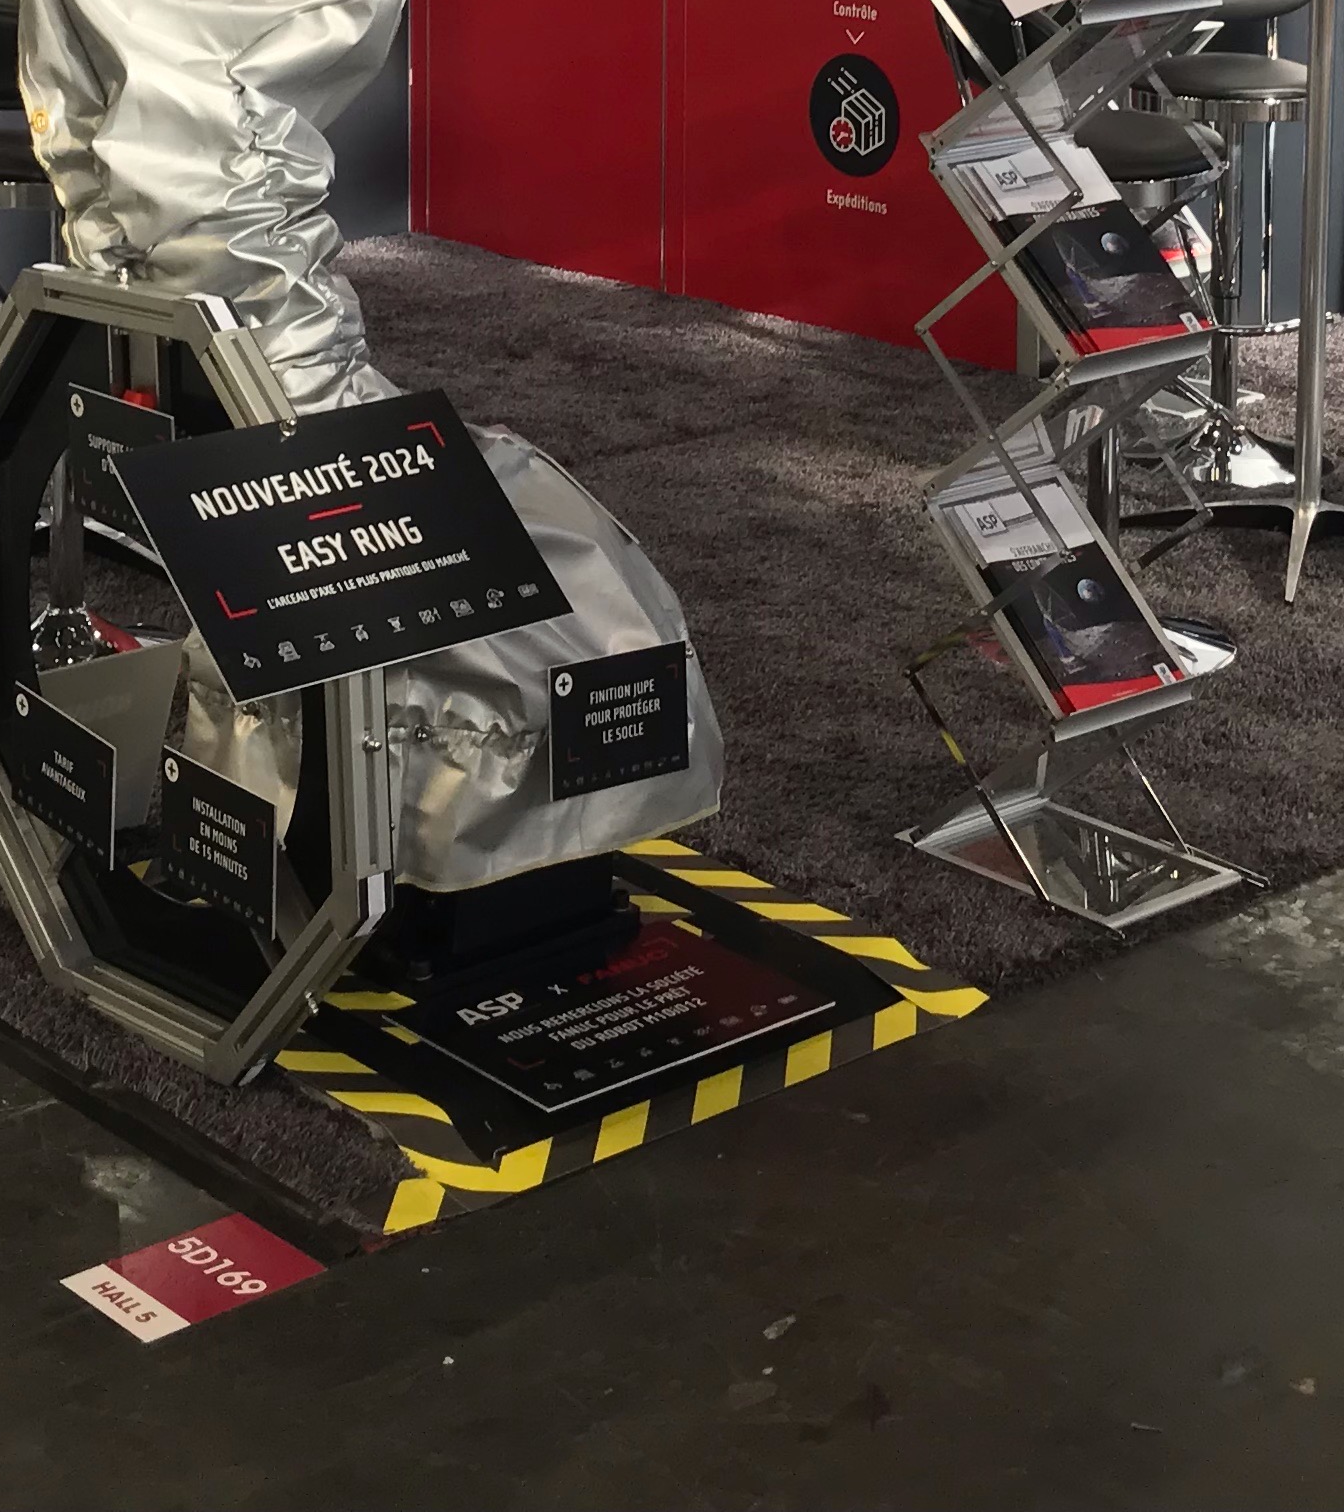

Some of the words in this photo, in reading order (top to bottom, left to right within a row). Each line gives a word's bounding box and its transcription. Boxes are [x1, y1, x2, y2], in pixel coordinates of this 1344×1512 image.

[833, 1, 878, 21] Contrôle
[995, 169, 1018, 186] ASP
[826, 190, 888, 215] Expéditions
[189, 453, 363, 522] NOUVEAUTÉ
[361, 443, 435, 484] 2024
[976, 514, 998, 531] ASP
[277, 533, 348, 575] EASY
[350, 515, 424, 558] RING
[267, 590, 309, 610] L'ARCEAU
[309, 584, 337, 600] D'AXE
[336, 582, 344, 593] 1
[344, 578, 357, 591] LE
[356, 572, 380, 589] PLUS
[379, 562, 422, 583] PRATIQUE
[421, 558, 436, 572] DU
[435, 548, 471, 568] MARCHÉ
[589, 684, 631, 706] FINITION
[633, 678, 655, 698] JUPE
[584, 709, 612, 727] POUR
[613, 698, 661, 721] PROTÉGER
[602, 729, 613, 744] LE
[615, 722, 644, 741] SOCLE
[54, 750, 74, 773] TARIF
[41, 762, 87, 803] AVANTAGEUX
[192, 796, 246, 837] INSTALLATION
[200, 821, 211, 840] EN
[212, 828, 238, 854] MOINS
[189, 836, 201, 855] DE
[202, 843, 212, 861] 15
[213, 847, 248, 881] MINUTES
[456, 992, 524, 1026] ASP
[497, 1023, 543, 1043] NOUS
[540, 992, 631, 1030] REMERCIONS
[627, 986, 650, 1000] LA
[645, 965, 704, 990] SOCIÉTÉ
[548, 1020, 599, 1041] FANUC
[596, 1007, 641, 1025] POUR
[637, 996, 658, 1011] LE
[654, 984, 692, 1004] PRÊT
[570, 1037, 597, 1051] DU
[598, 1019, 646, 1042] ROBOT
[167, 1236, 268, 1295] 5D169
[91, 1281, 137, 1315] HALL
[135, 1311, 158, 1324] 5
